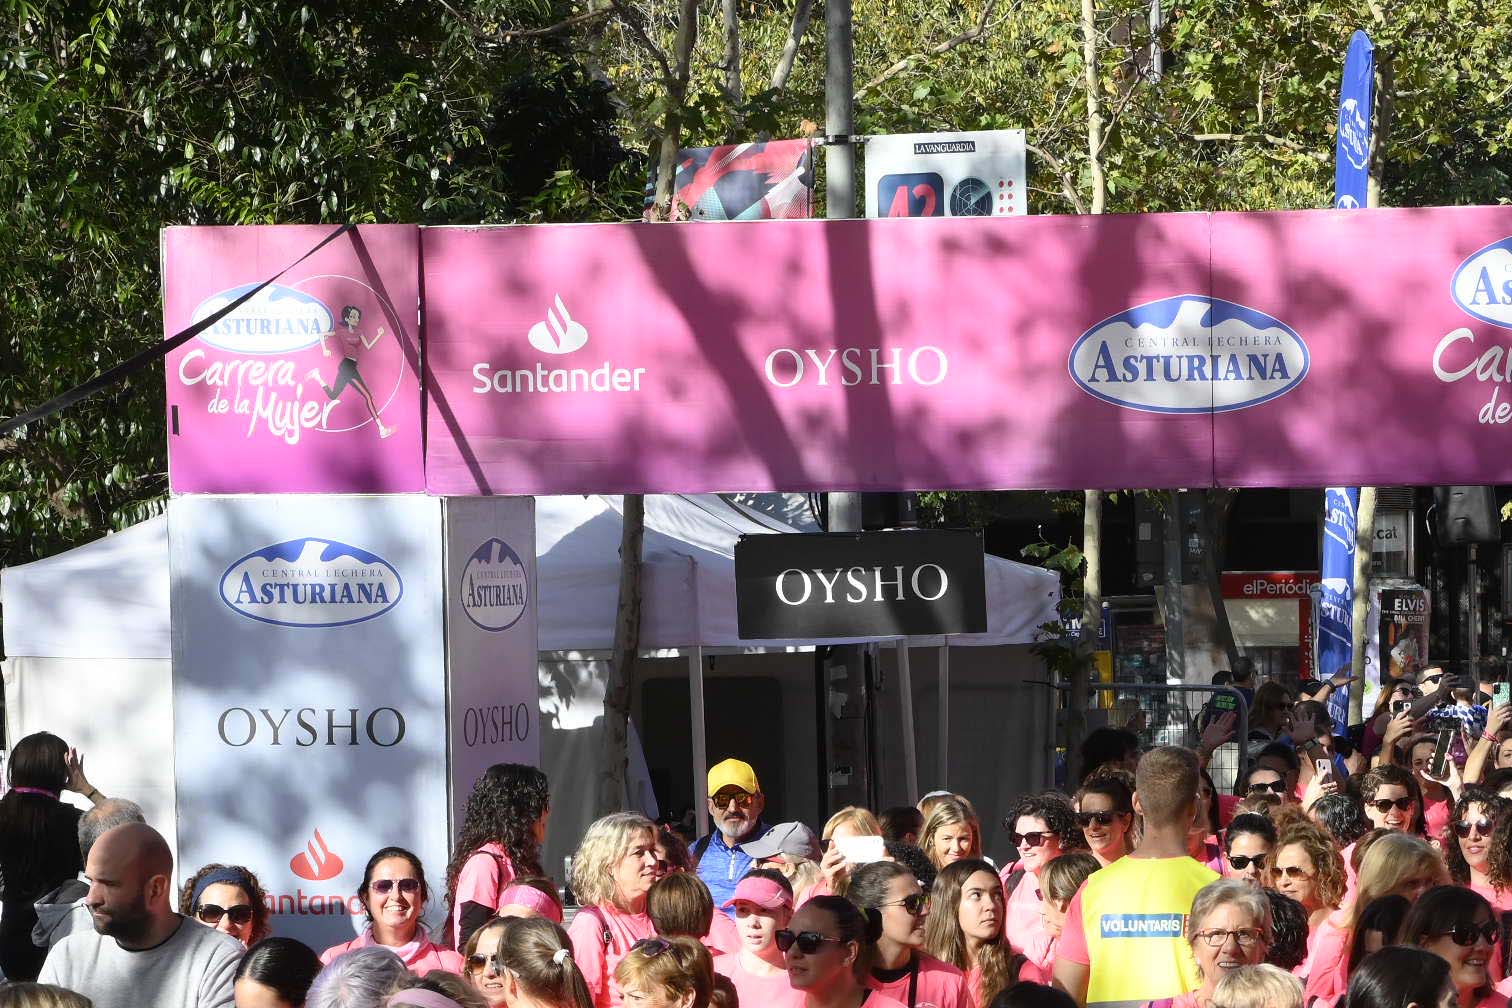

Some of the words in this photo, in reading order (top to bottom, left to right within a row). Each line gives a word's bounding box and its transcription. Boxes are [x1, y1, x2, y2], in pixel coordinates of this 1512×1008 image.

[1124, 336, 1200, 349] CENTRAL
[1207, 335, 1283, 348] LECHERA
[178, 349, 296, 386] Carrera
[472, 361, 646, 393] Santander
[765, 346, 949, 387] OYSHO
[1088, 339, 1292, 383] ASTURIANA
[207, 388, 230, 414] de
[234, 386, 249, 414] la
[246, 384, 342, 445] Mujer
[1478, 386, 1512, 424] de
[234, 571, 390, 605] ASTURIANA
[261, 568, 320, 578] CENTRAL
[325, 568, 384, 578] LECHERA
[466, 572, 525, 608] ASTURIANA
[775, 563, 949, 606] OYSHO
[1394, 598, 1425, 612] ELVIS
[217, 706, 407, 747] OYSHO
[463, 702, 530, 748] OYSHO
[1102, 919, 1181, 932] VOLUNTARIS
